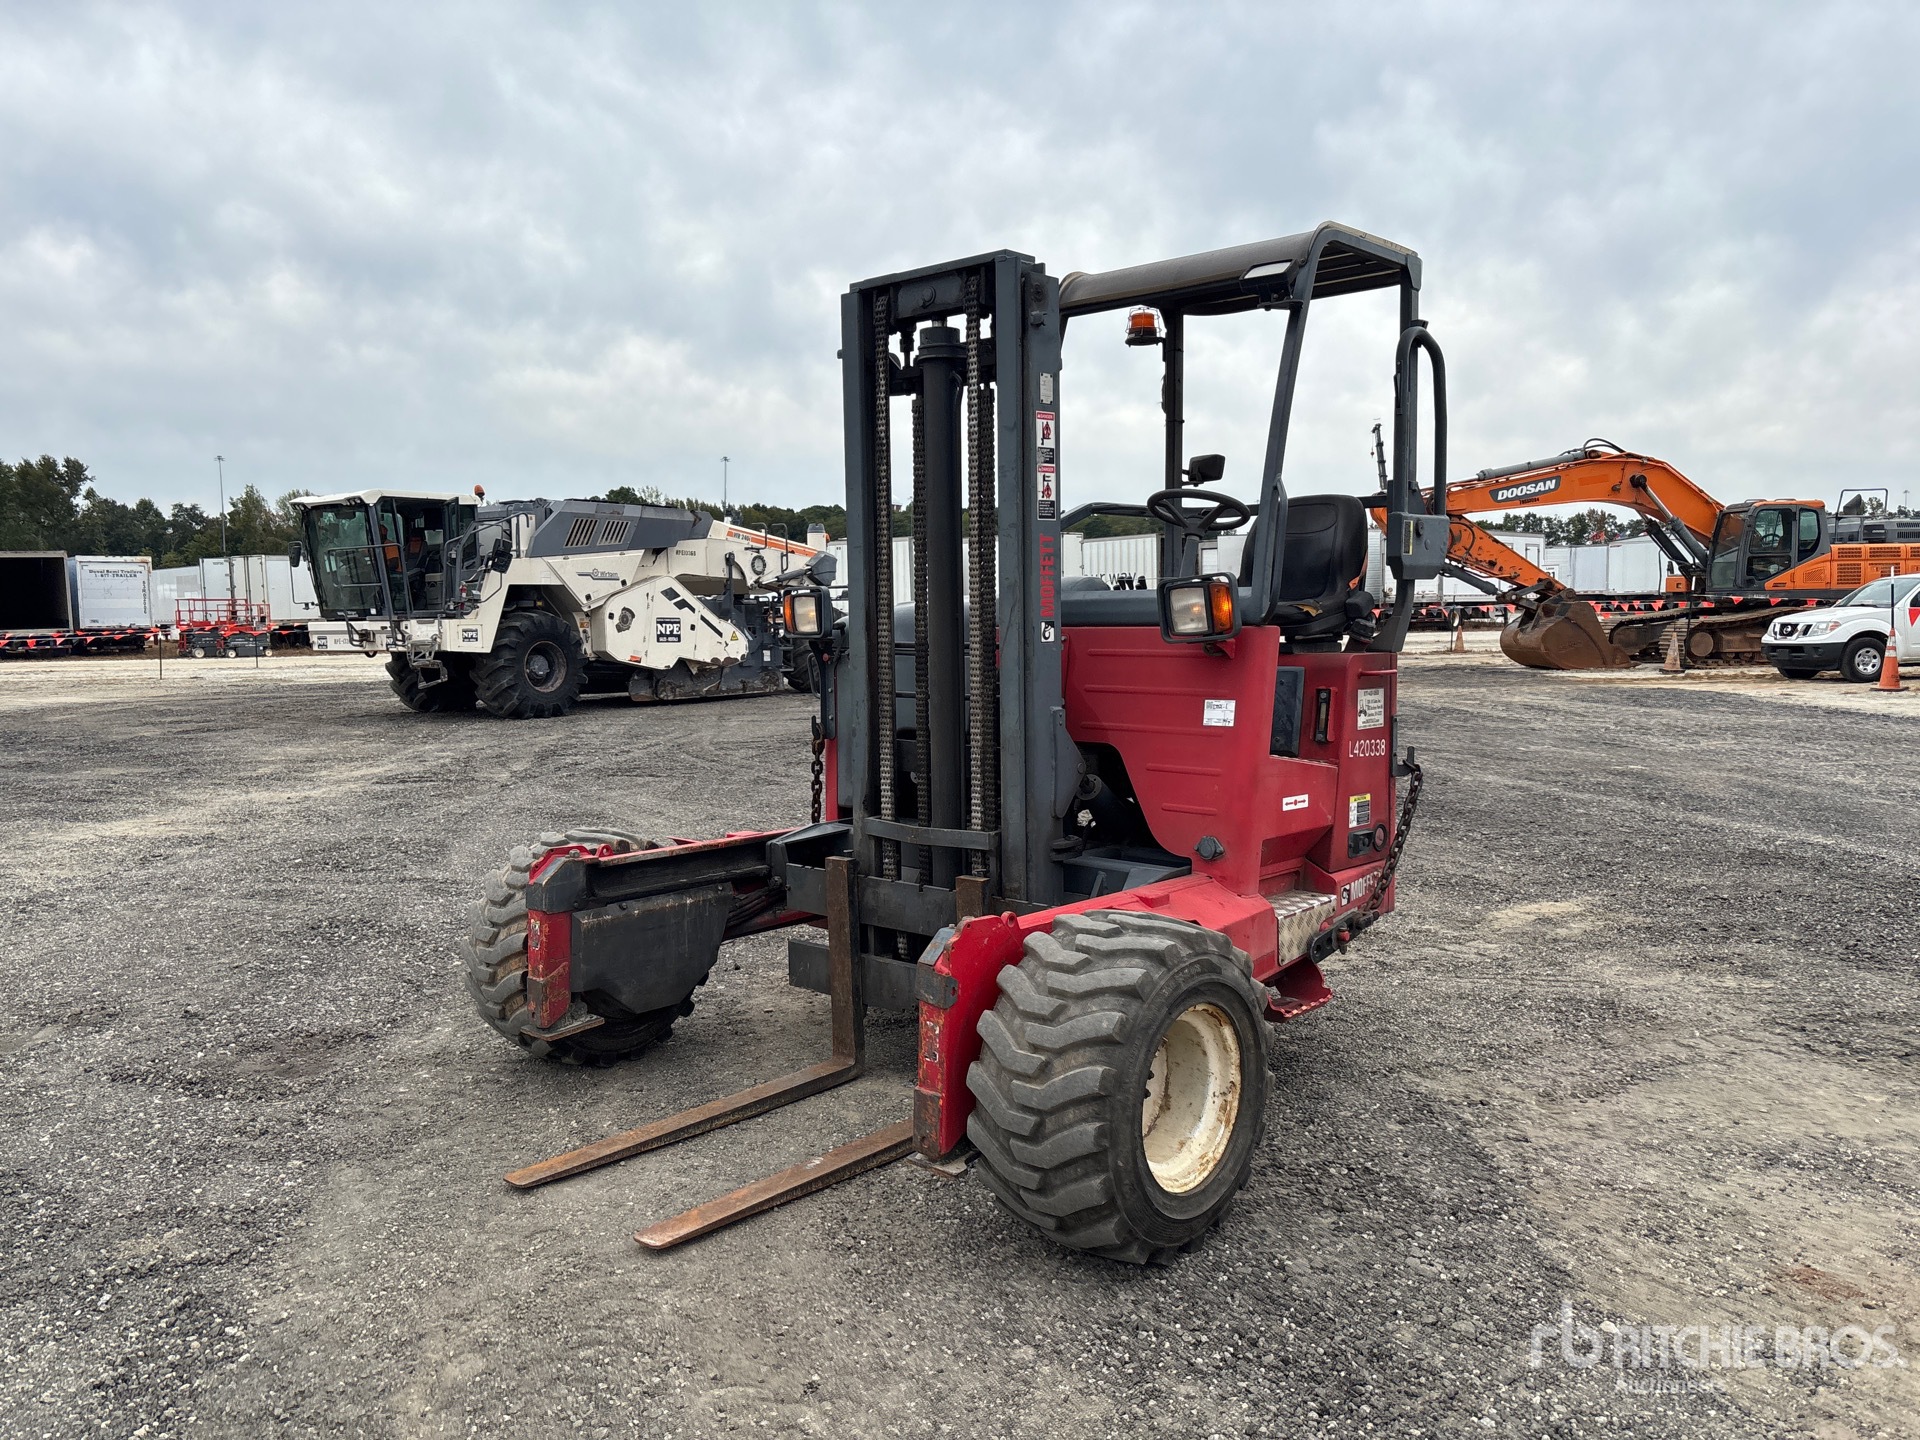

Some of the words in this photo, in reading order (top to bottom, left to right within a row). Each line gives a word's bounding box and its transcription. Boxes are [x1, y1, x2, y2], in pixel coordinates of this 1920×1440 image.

[1497, 479, 1556, 501] DOOSAN
[1039, 533, 1054, 617] MOFFETT
[657, 624, 681, 635] NPE
[1349, 738, 1386, 757] L420338
